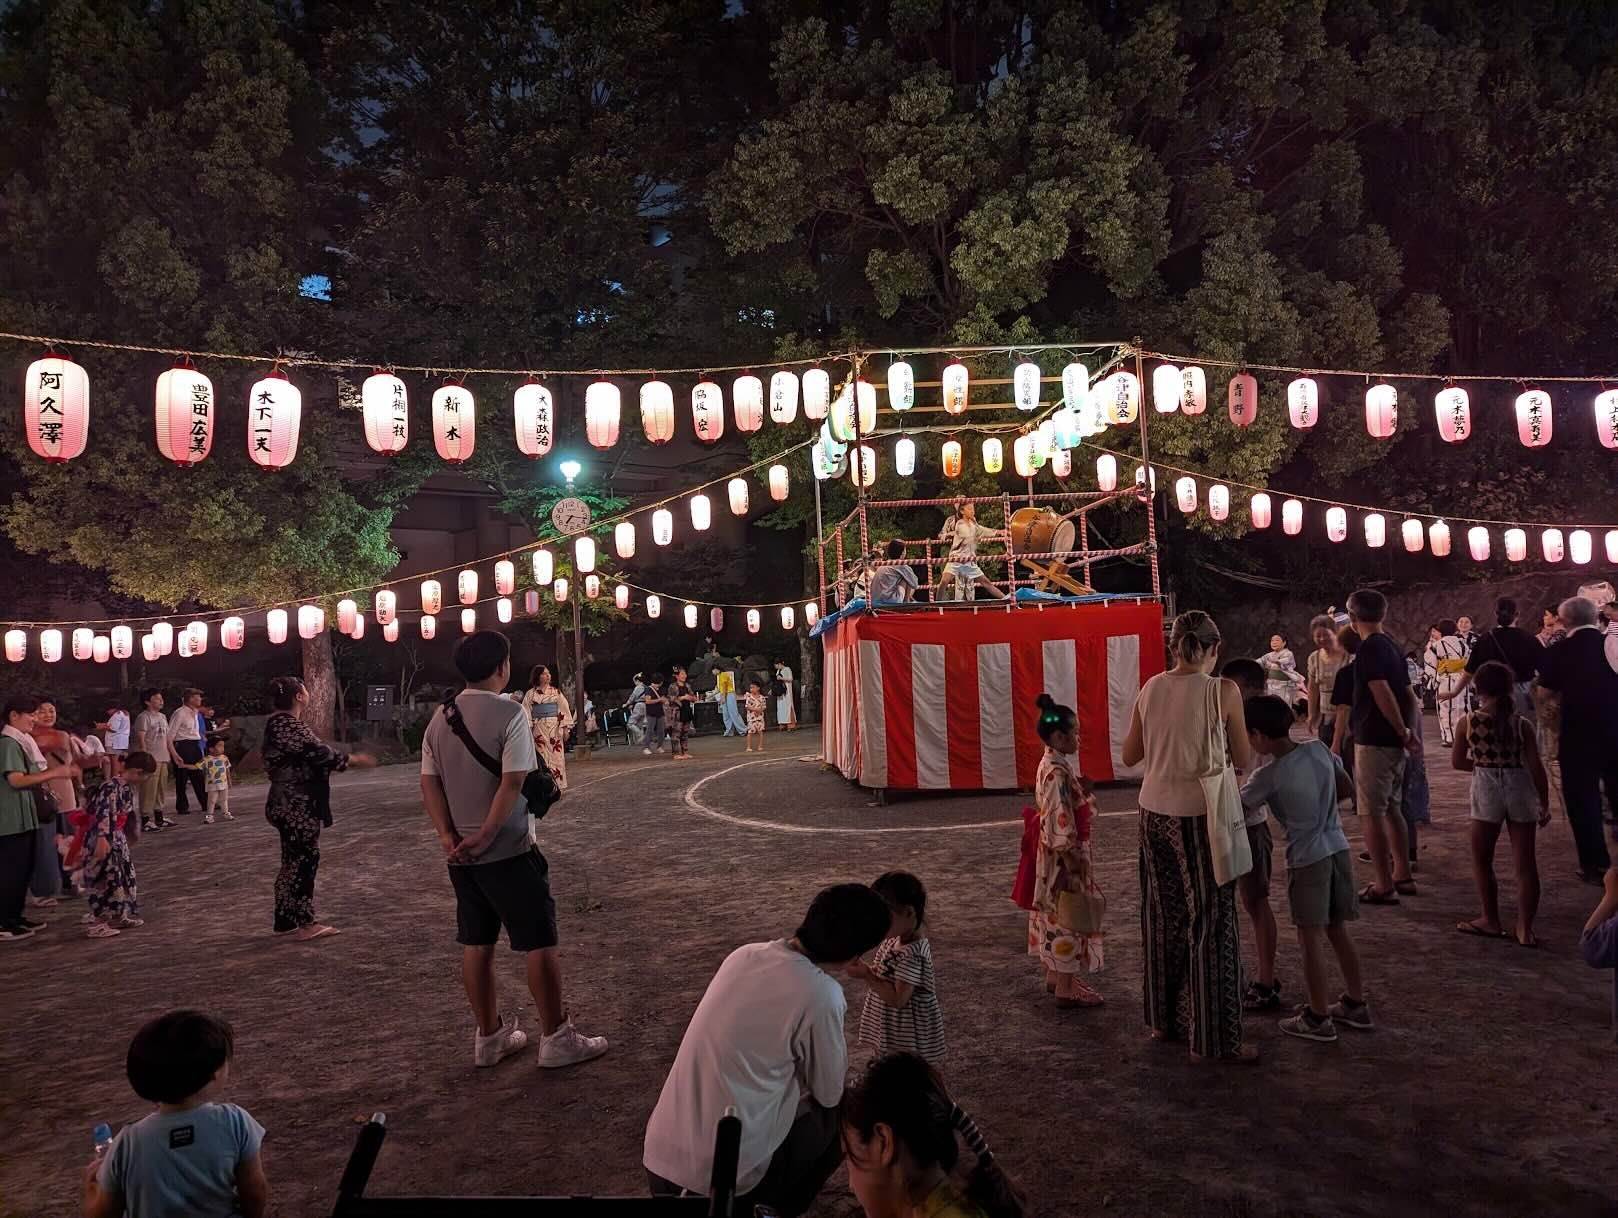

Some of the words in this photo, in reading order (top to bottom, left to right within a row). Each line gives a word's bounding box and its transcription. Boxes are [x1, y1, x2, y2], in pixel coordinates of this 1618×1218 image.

[40, 372, 64, 444] 阿久澤
[444, 396, 461, 440] 新木
